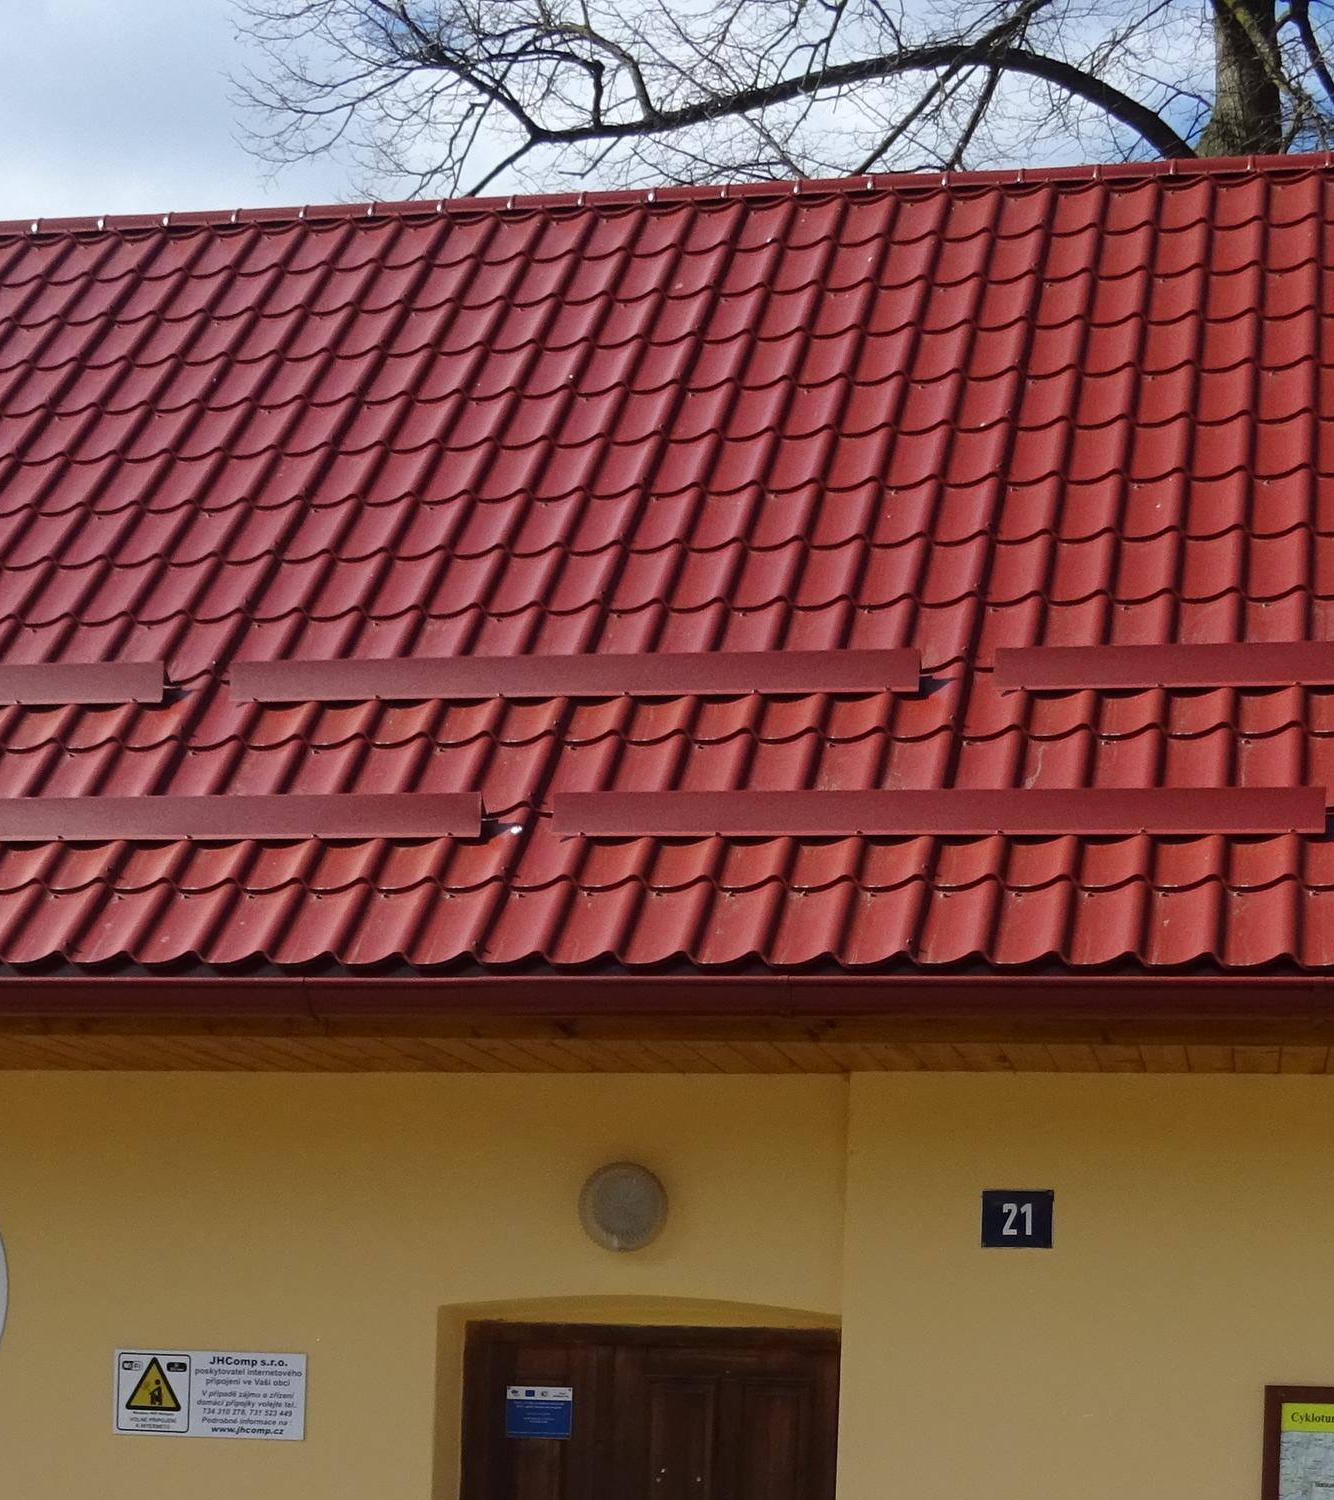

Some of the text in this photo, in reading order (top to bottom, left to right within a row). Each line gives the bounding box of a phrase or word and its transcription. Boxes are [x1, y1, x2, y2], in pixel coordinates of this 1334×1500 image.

[1002, 1202, 1033, 1236] 21
[209, 1356, 288, 1368] JHComp s.r.o.
[195, 1367, 246, 1377] poskytovatel
[247, 1368, 303, 1378] internetového
[205, 1377, 241, 1387] připojení
[239, 1417, 276, 1426] informace
[211, 1425, 285, 1435] www.jhcomp.cz
